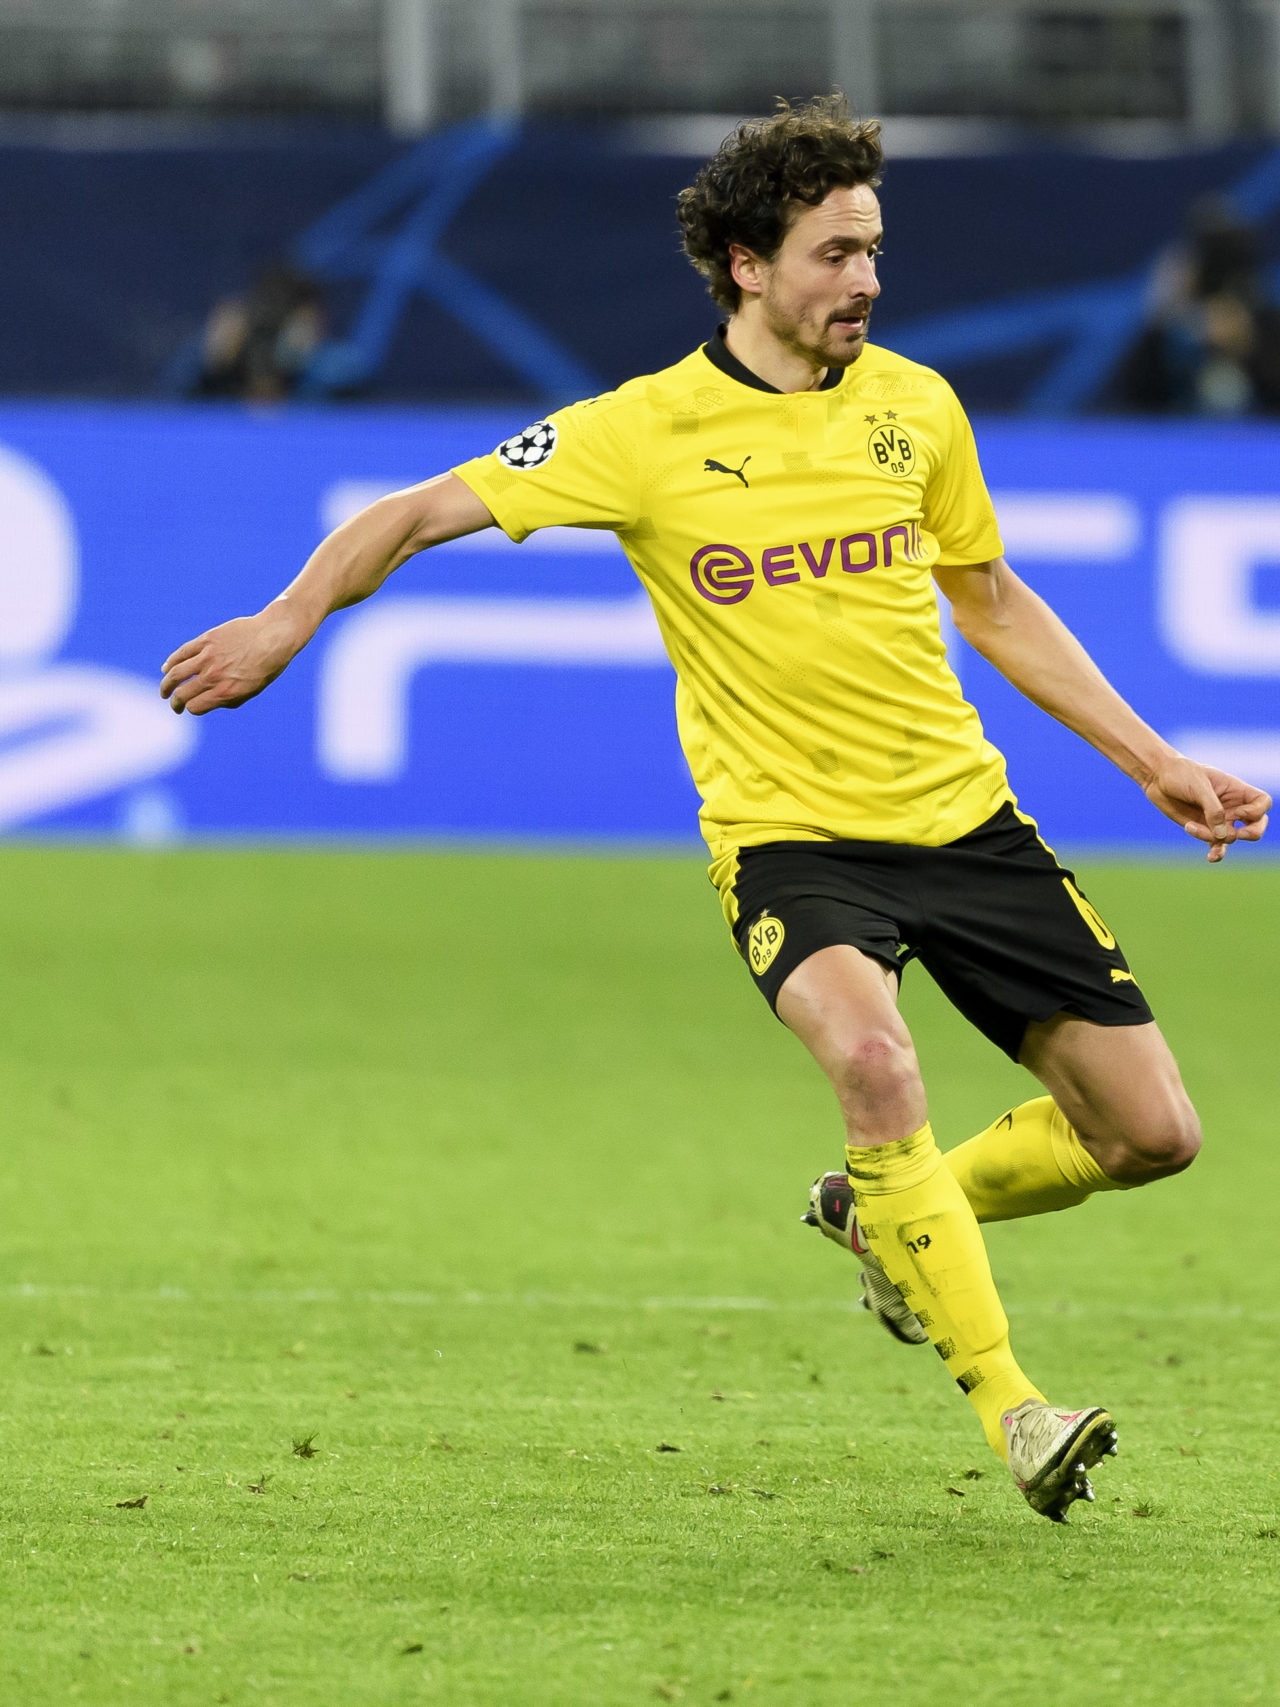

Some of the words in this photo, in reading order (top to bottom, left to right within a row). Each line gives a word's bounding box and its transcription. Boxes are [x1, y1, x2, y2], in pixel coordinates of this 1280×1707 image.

[873, 429, 912, 465] BVB
[891, 461, 905, 473] 09
[751, 925, 778, 966] BVB
[907, 1234, 932, 1254] 19
